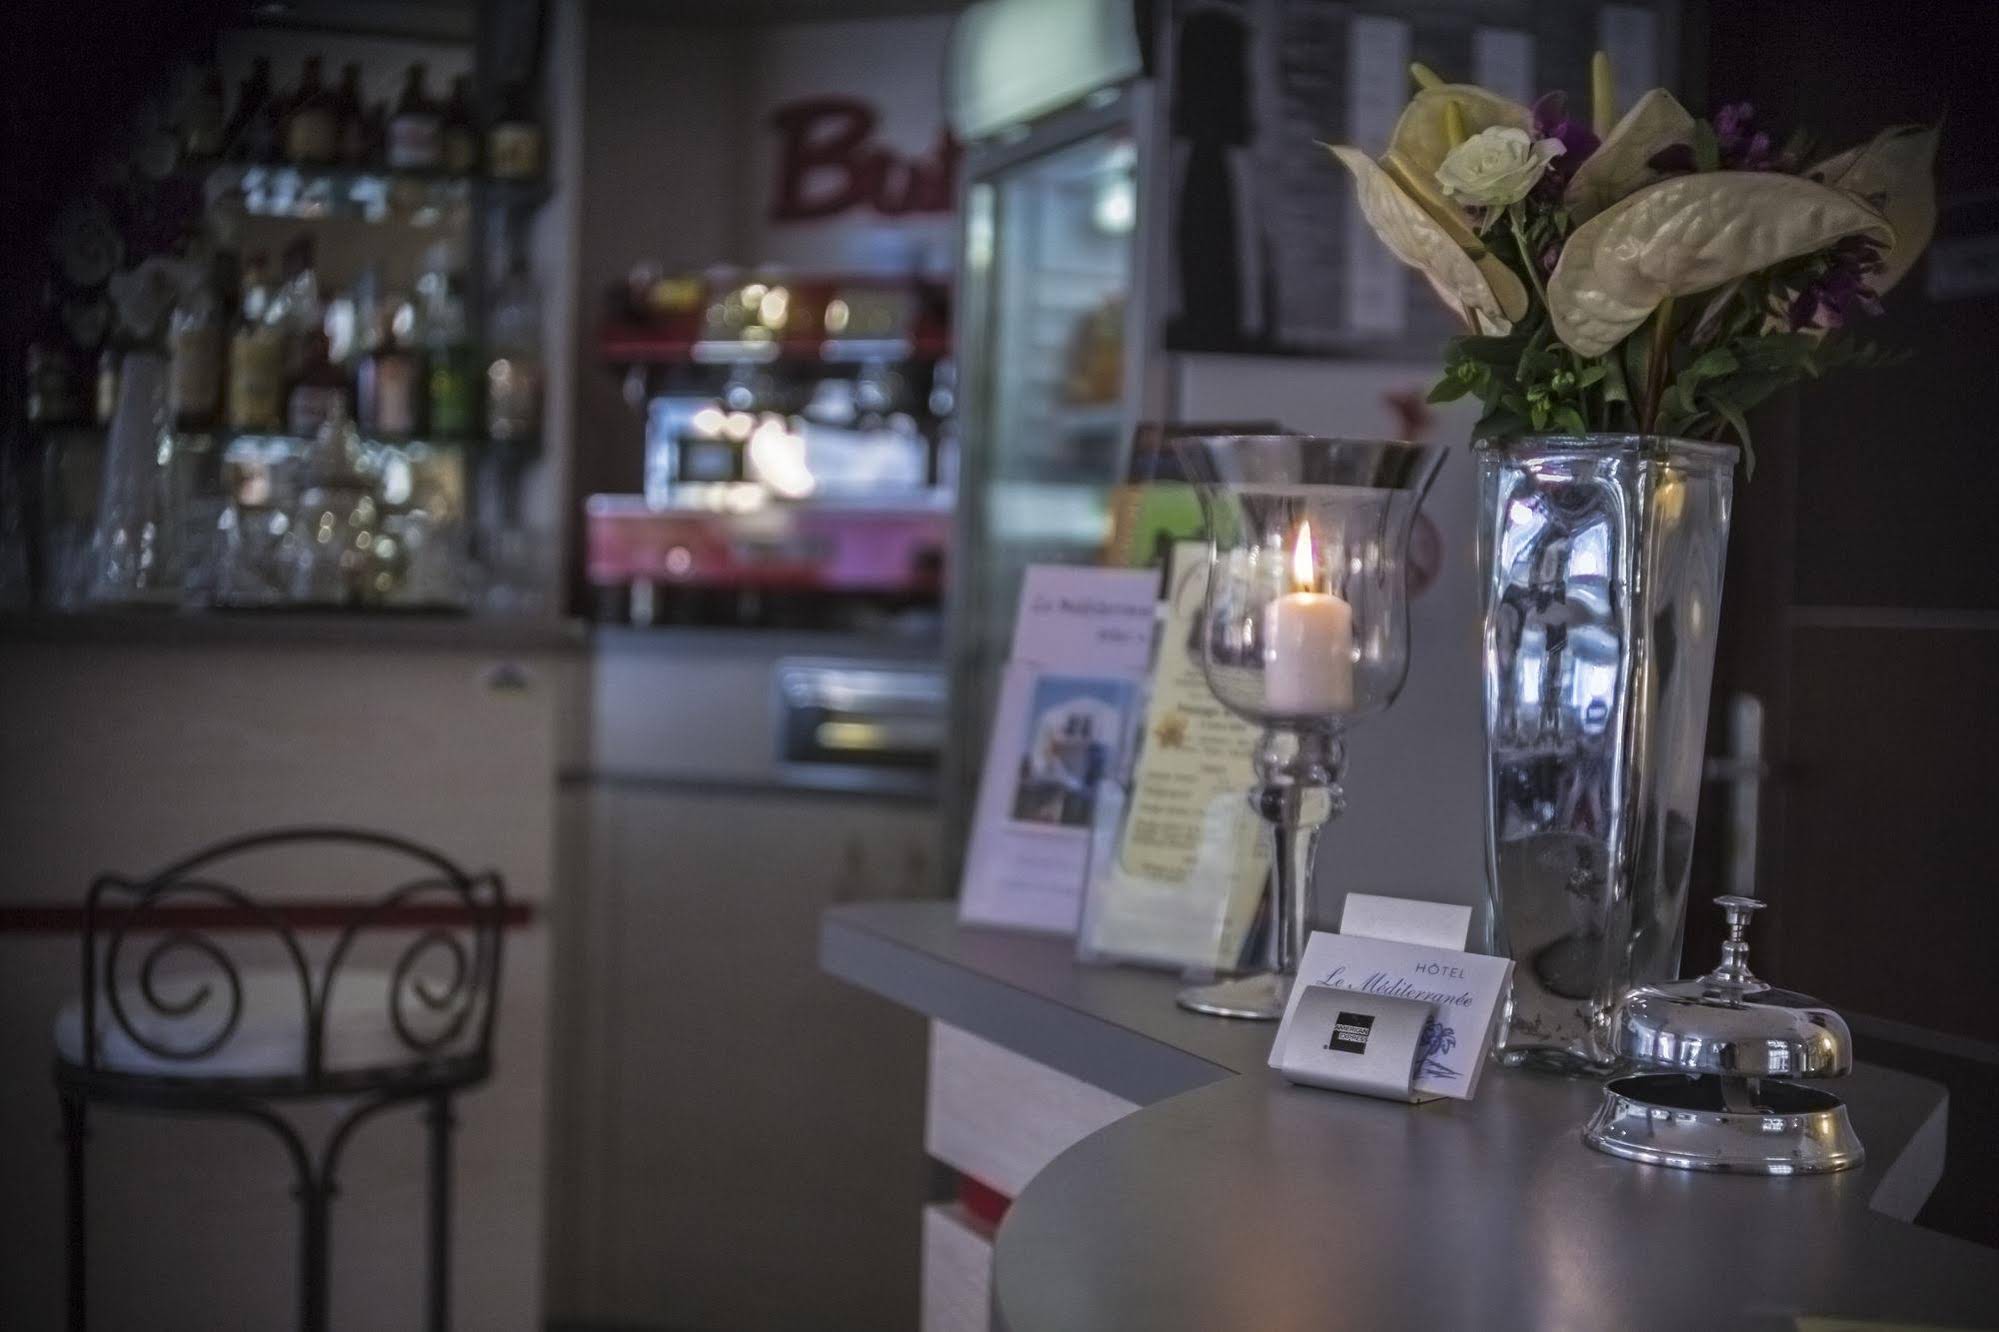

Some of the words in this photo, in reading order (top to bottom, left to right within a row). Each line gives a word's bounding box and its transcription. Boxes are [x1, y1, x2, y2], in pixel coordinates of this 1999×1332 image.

[1316, 966, 1346, 987] Le
[1415, 963, 1465, 979] HÔTEL
[1334, 1023, 1370, 1035] AMERICAN
